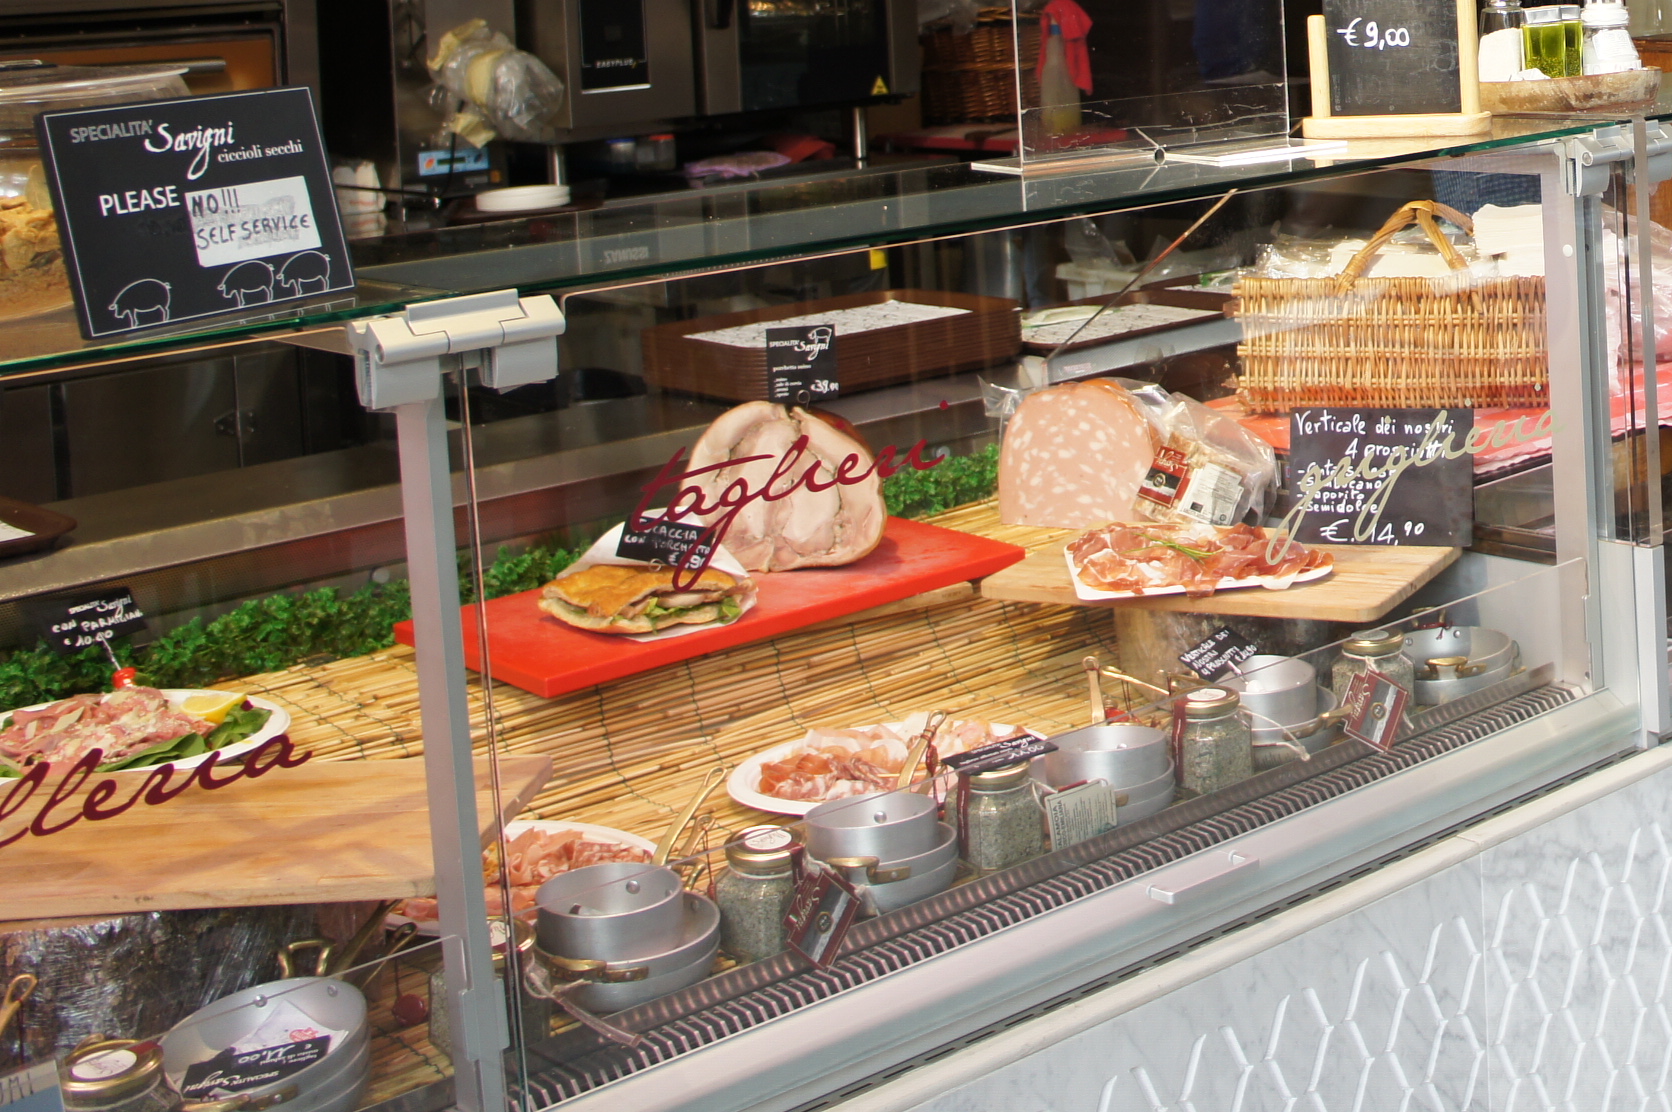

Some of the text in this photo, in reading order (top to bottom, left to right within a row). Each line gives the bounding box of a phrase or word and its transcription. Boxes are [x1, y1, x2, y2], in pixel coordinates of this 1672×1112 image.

[145, 122, 235, 180] Savigni
[218, 140, 303, 163] ciccioli secchi
[100, 185, 180, 217] PLEASE
[196, 214, 310, 250] SELF SERVICE
[1295, 410, 1396, 435] Verticale dei
[1346, 438, 1359, 458] 4
